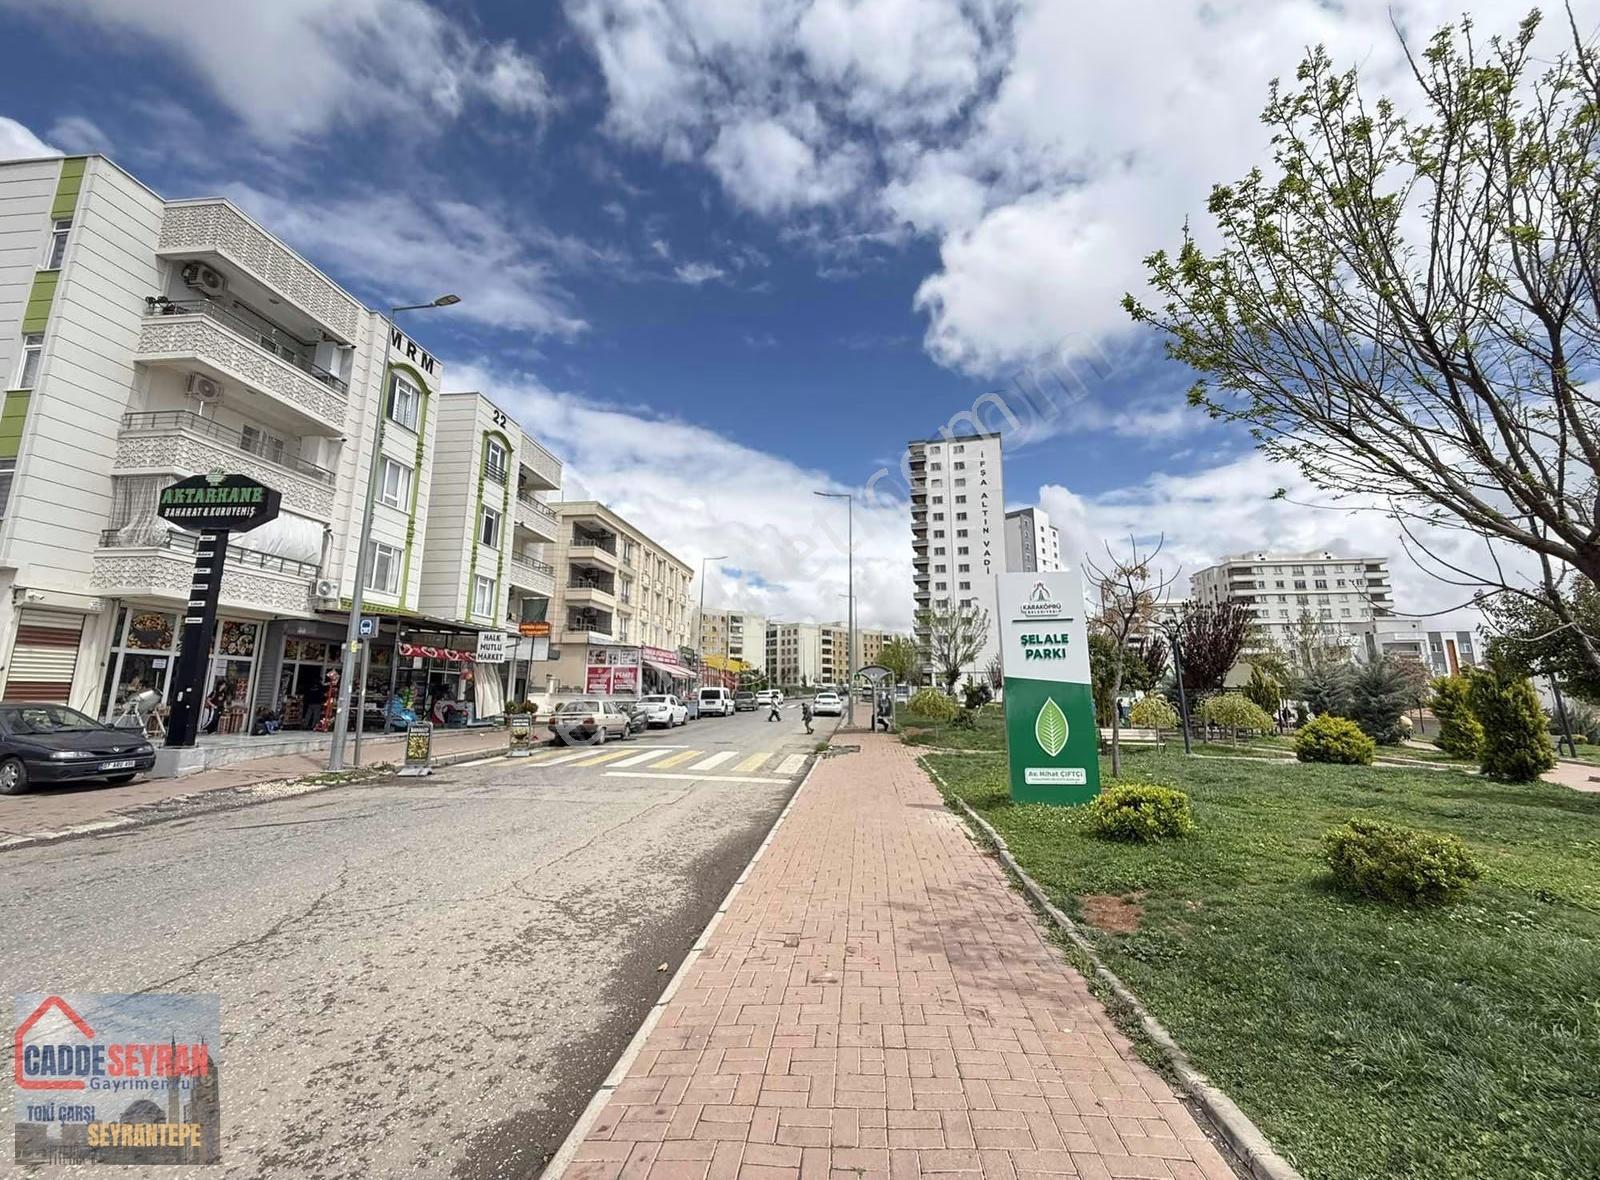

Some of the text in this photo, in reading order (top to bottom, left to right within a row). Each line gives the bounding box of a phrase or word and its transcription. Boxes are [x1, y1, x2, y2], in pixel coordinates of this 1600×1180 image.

[493, 409, 507, 429] 22
[161, 487, 263, 503] AKTARHANE
[164, 507, 200, 517] BAHARAT
[981, 492, 989, 534] ALTIN
[484, 633, 501, 641] HALK
[1020, 633, 1069, 647] ŞELALE
[480, 643, 502, 651] MUTLU
[478, 653, 503, 661] MARKET
[1025, 648, 1066, 660] PARKI
